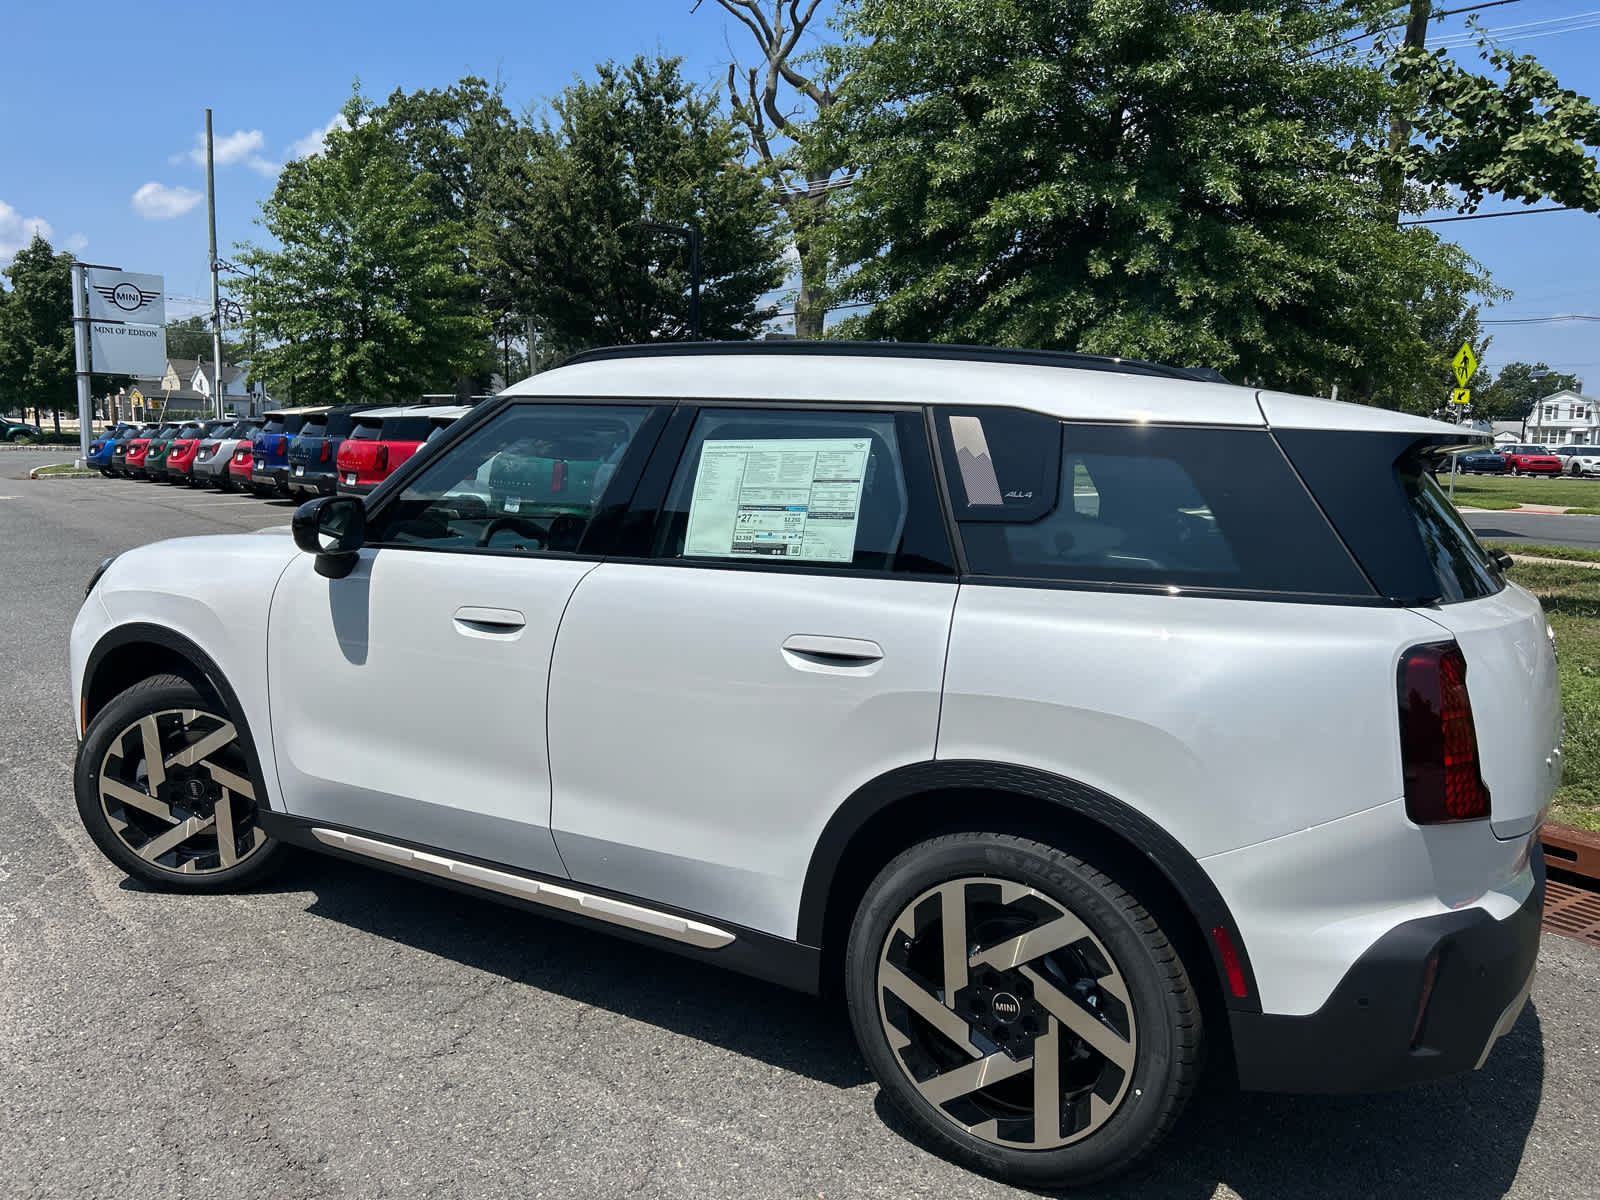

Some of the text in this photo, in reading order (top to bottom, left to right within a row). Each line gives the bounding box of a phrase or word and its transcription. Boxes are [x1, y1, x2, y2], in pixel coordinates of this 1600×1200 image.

[116, 292, 139, 302] MINI
[94, 326, 114, 335] MINI
[128, 329, 158, 337] EDISON
[740, 513, 753, 523] 27
[995, 1002, 1016, 1013] MINI
